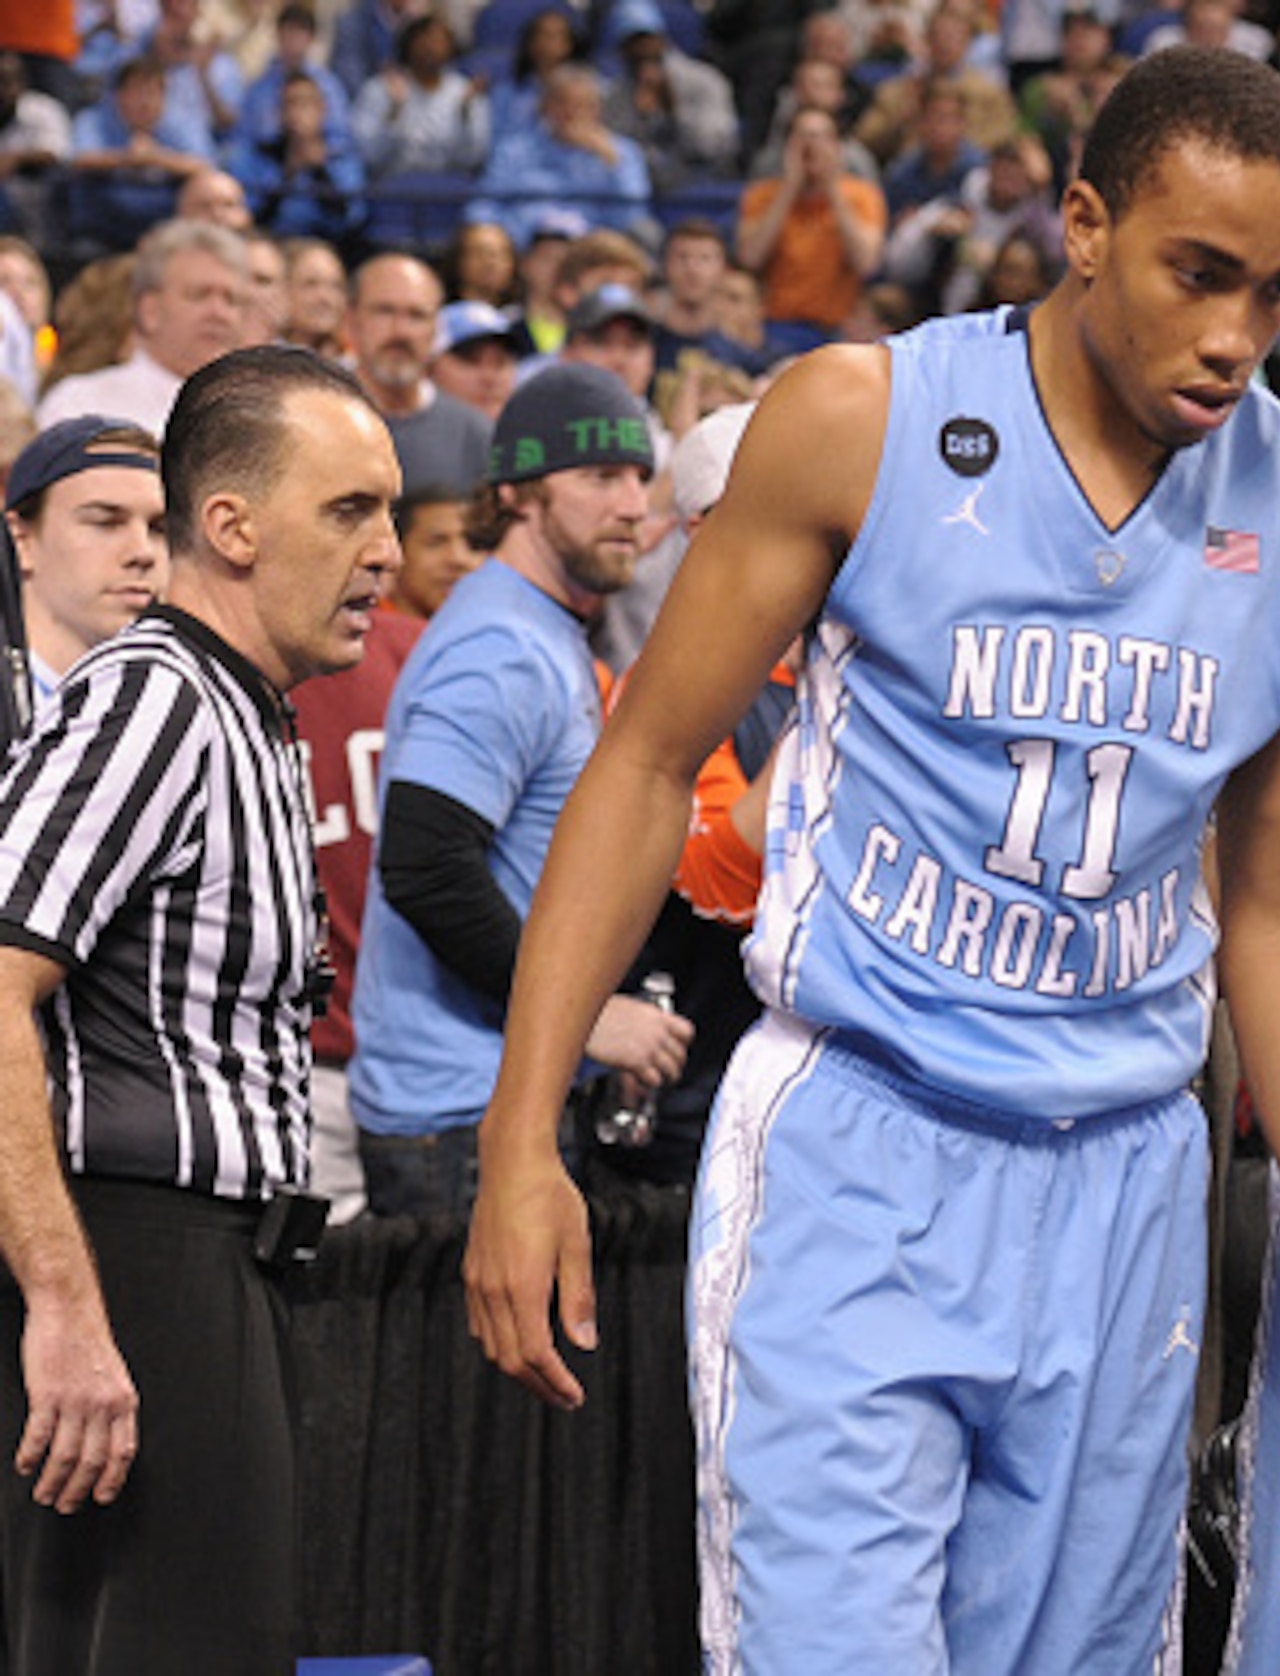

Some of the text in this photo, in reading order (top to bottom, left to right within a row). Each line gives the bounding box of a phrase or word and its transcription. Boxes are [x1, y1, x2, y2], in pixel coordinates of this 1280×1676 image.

[568, 418, 649, 453] THE
[942, 625, 1219, 749] NORTH
[984, 737, 1135, 899] 11
[847, 822, 1179, 998] CAROLINA
